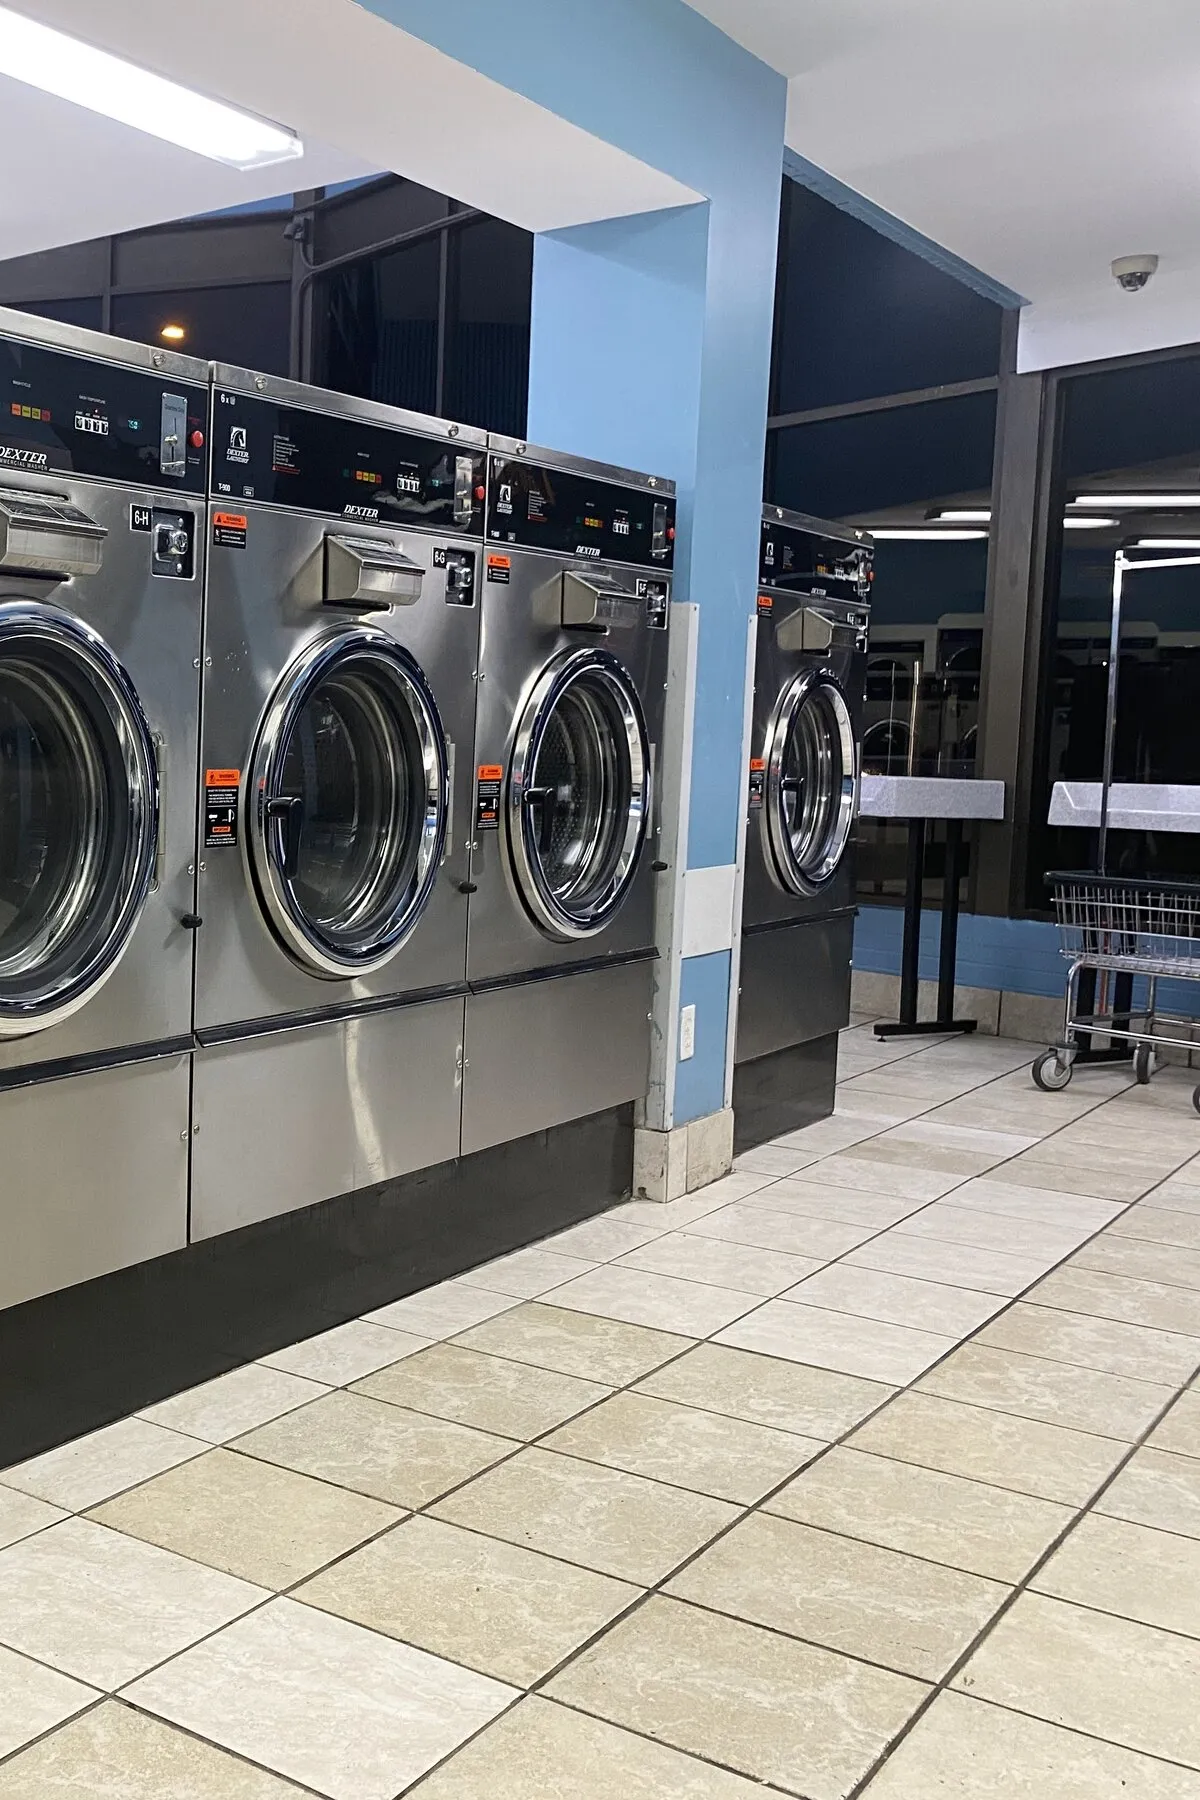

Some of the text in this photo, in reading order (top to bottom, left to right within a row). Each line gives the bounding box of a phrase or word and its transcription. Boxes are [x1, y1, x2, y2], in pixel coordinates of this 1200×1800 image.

[220, 393, 225, 404] 6
[134, 509, 149, 526] 6-H
[343, 504, 379, 519] DEXTER
[575, 545, 601, 557] DEXTER
